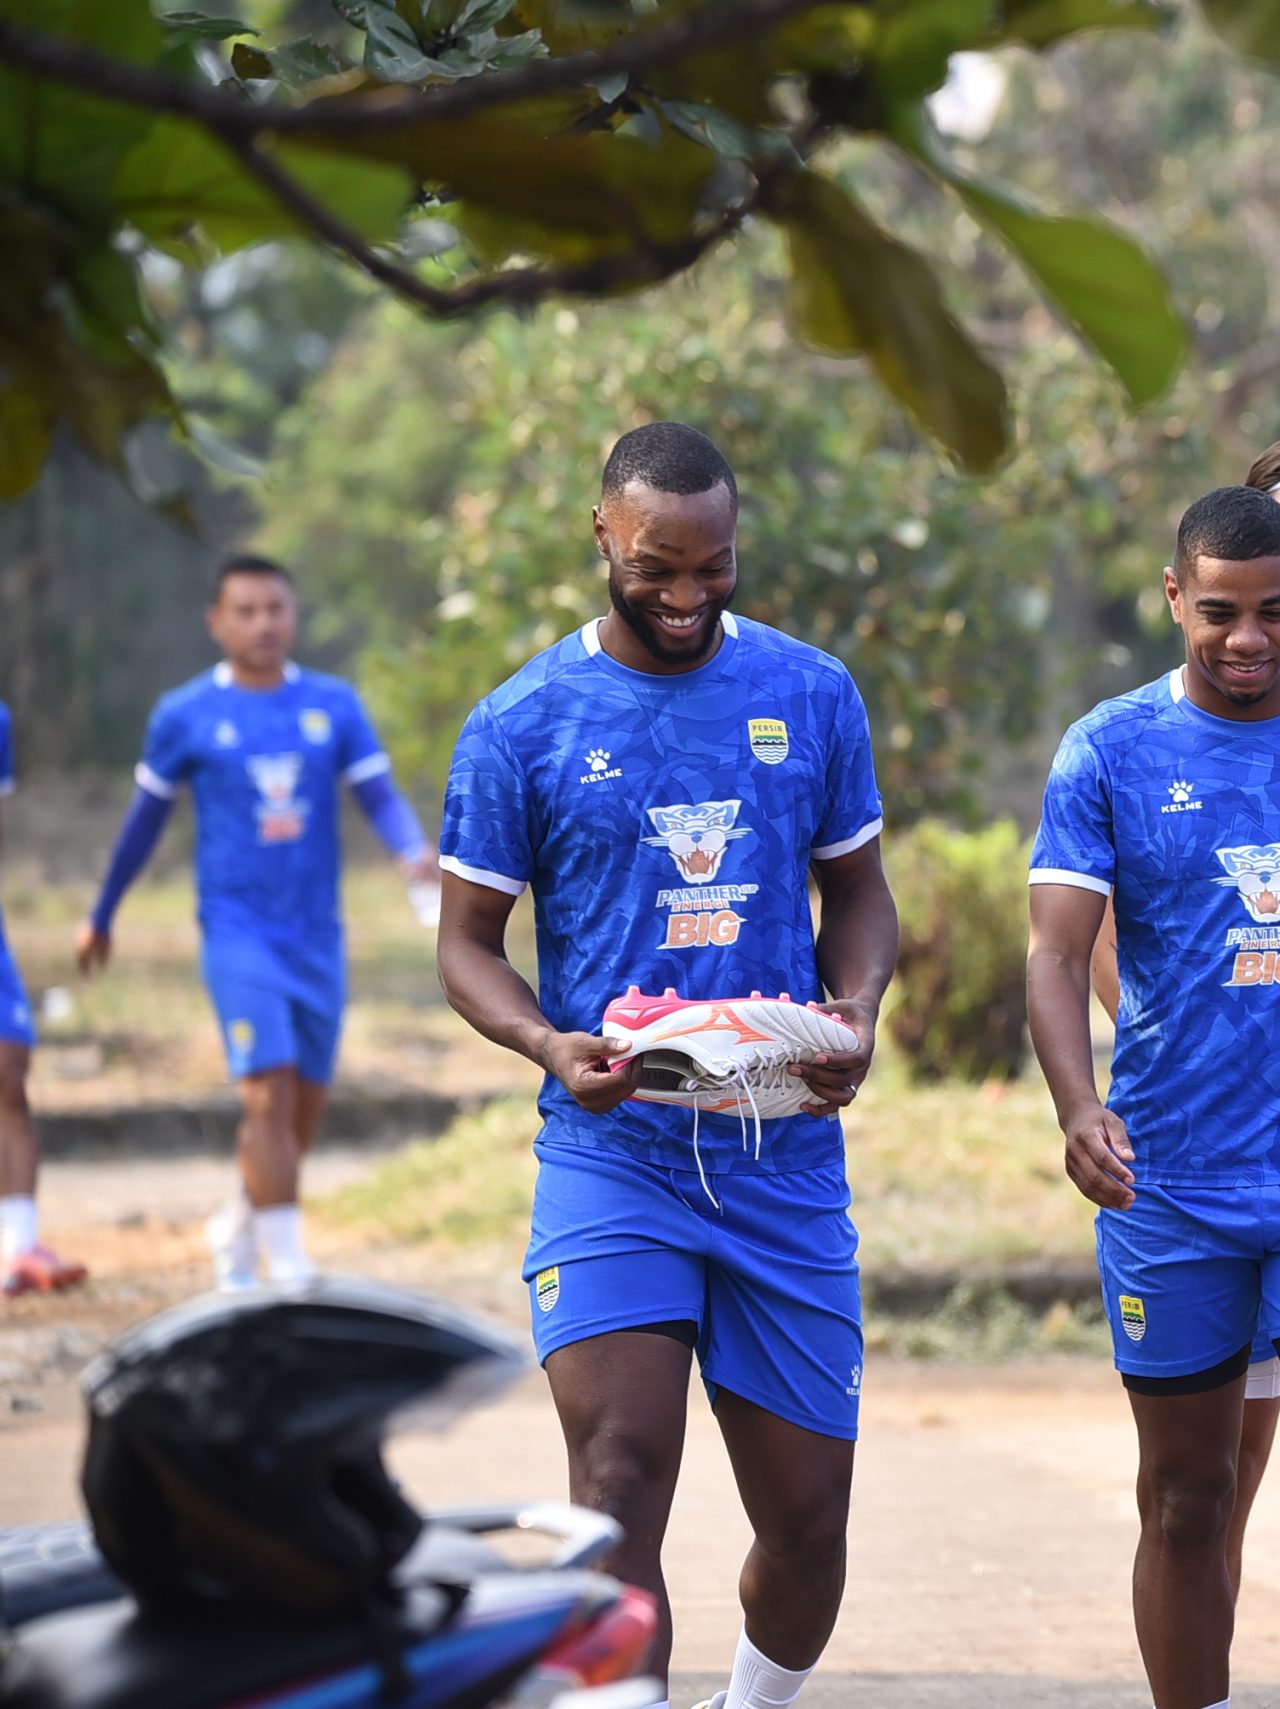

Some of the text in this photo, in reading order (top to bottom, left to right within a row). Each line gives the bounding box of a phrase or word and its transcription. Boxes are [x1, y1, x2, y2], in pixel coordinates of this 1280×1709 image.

[580, 768, 623, 784] KELME
[1161, 801, 1202, 813] KELME
[655, 885, 742, 907] PANTHER
[671, 900, 731, 912] ENERGI
[660, 910, 744, 949] BIG
